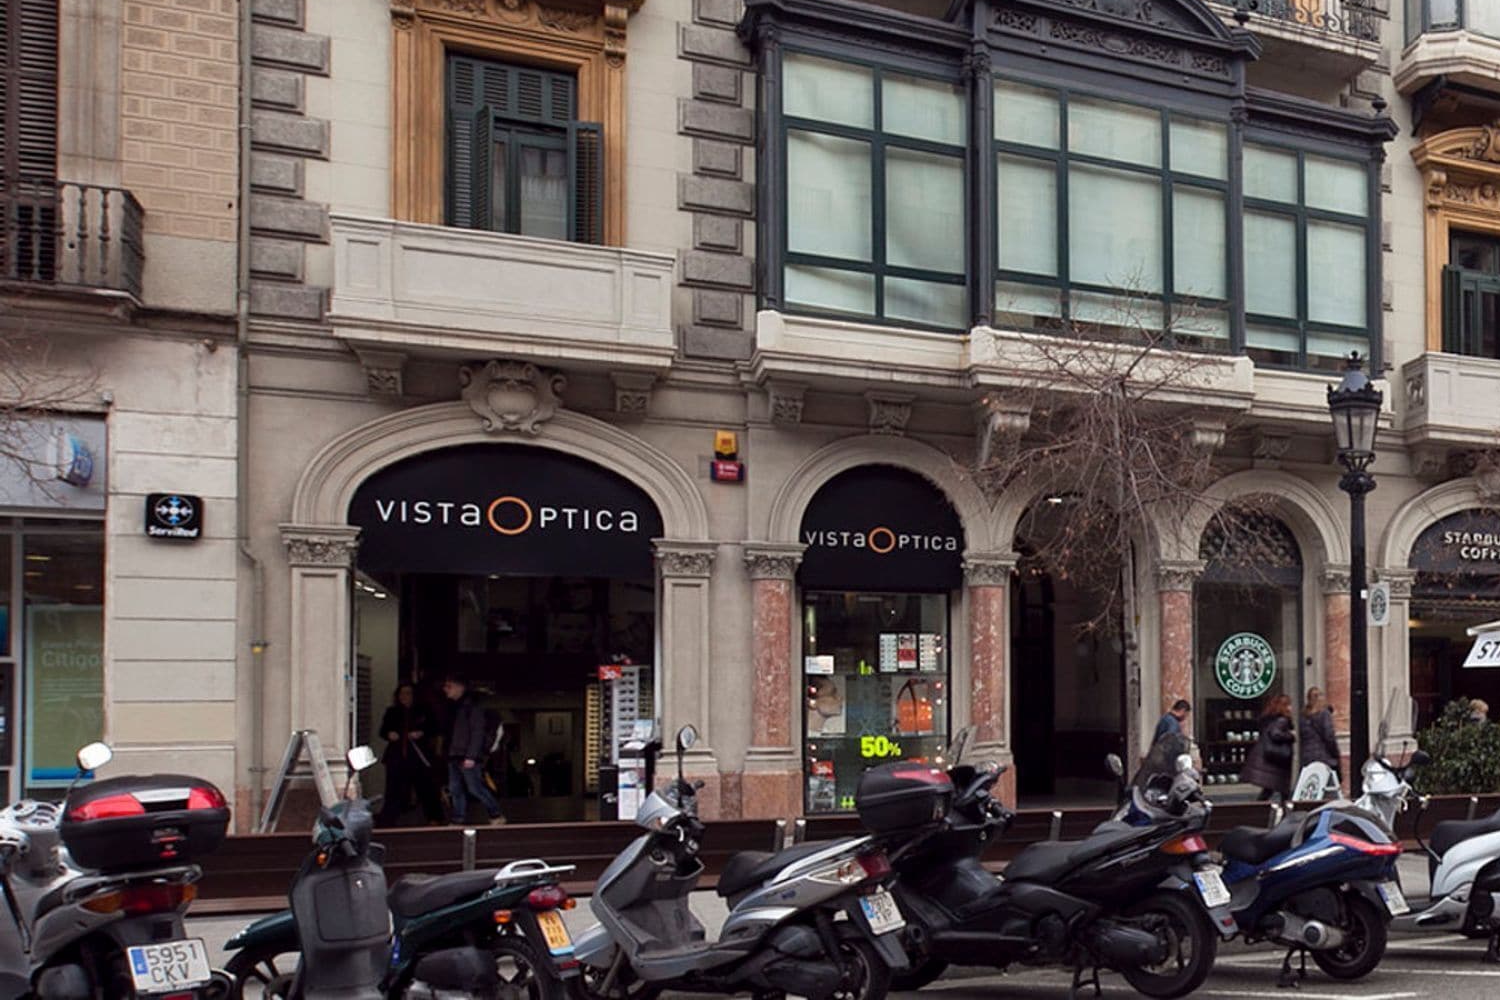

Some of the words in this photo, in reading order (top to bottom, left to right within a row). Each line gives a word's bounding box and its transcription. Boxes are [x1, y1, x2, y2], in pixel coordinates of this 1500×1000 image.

[1220, 637, 1272, 663] STARBUCKS
[1226, 679, 1265, 695] COFFEE
[861, 735, 902, 758] 50%
[145, 943, 197, 966] 5951
[151, 962, 189, 984] CKV
